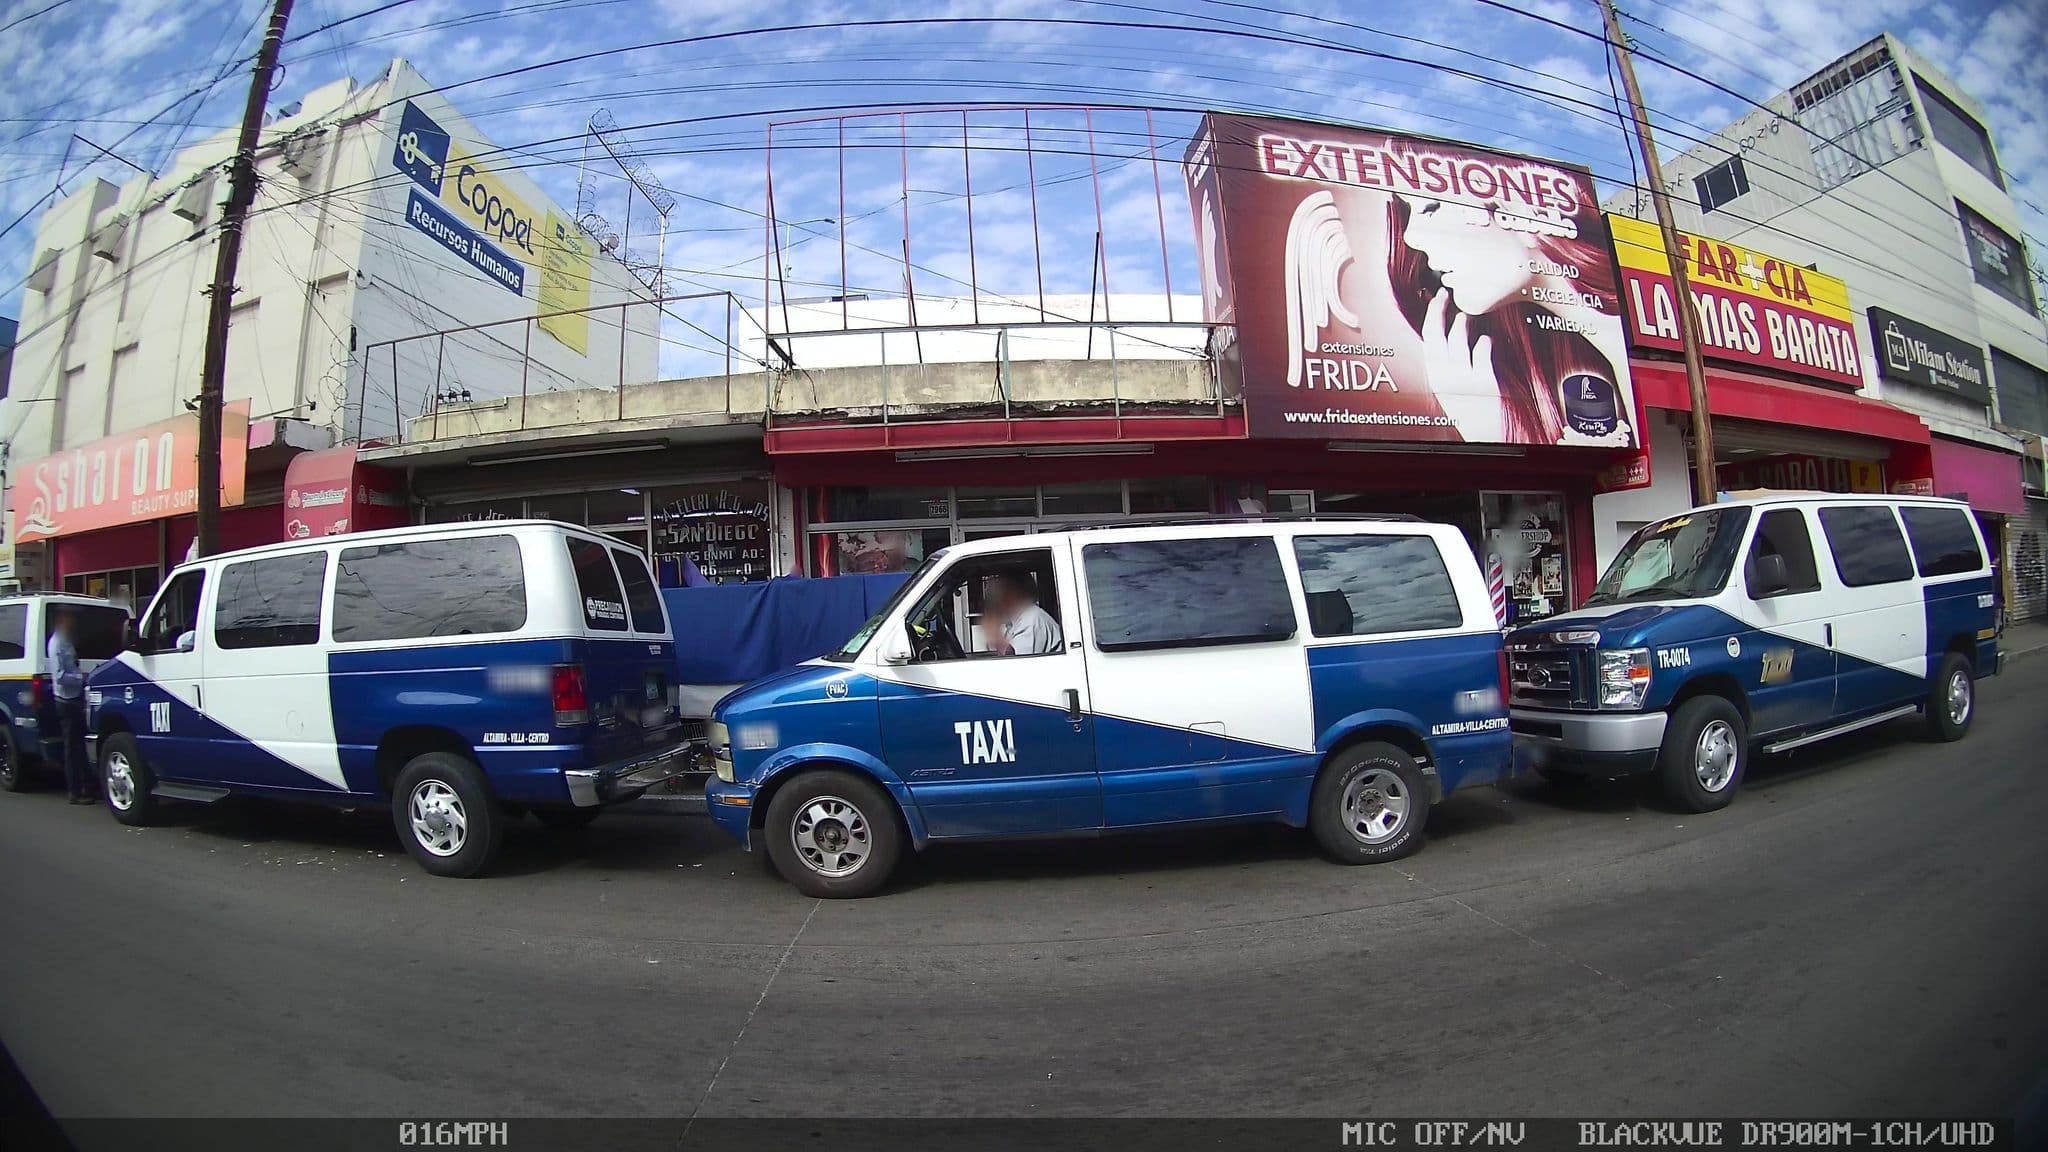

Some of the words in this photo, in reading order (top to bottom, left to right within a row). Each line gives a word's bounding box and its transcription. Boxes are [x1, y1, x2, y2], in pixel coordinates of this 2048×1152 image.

[1262, 137, 1577, 213] EXTENSIONES
[456, 164, 534, 256] Coppel
[410, 199, 469, 254] Recursos
[470, 239, 520, 289] Humanos
[1528, 259, 1580, 279] CALIDAD
[1630, 278, 1680, 340] LA
[1691, 288, 1761, 355] MAS
[1764, 307, 1860, 377] BARATA
[1321, 341, 1395, 357] extensiones
[1906, 336, 1947, 372] Milam
[1945, 351, 1983, 385] Station
[1305, 357, 1399, 393] FRIDA
[1284, 408, 1460, 427] www.fridaextensiones.com
[131, 494, 170, 515] BEAUTY
[1657, 647, 1691, 669] TR-0074
[150, 701, 171, 733] TAXI
[528, 732, 549, 744] CENTRO
[954, 718, 1016, 765] TAXI
